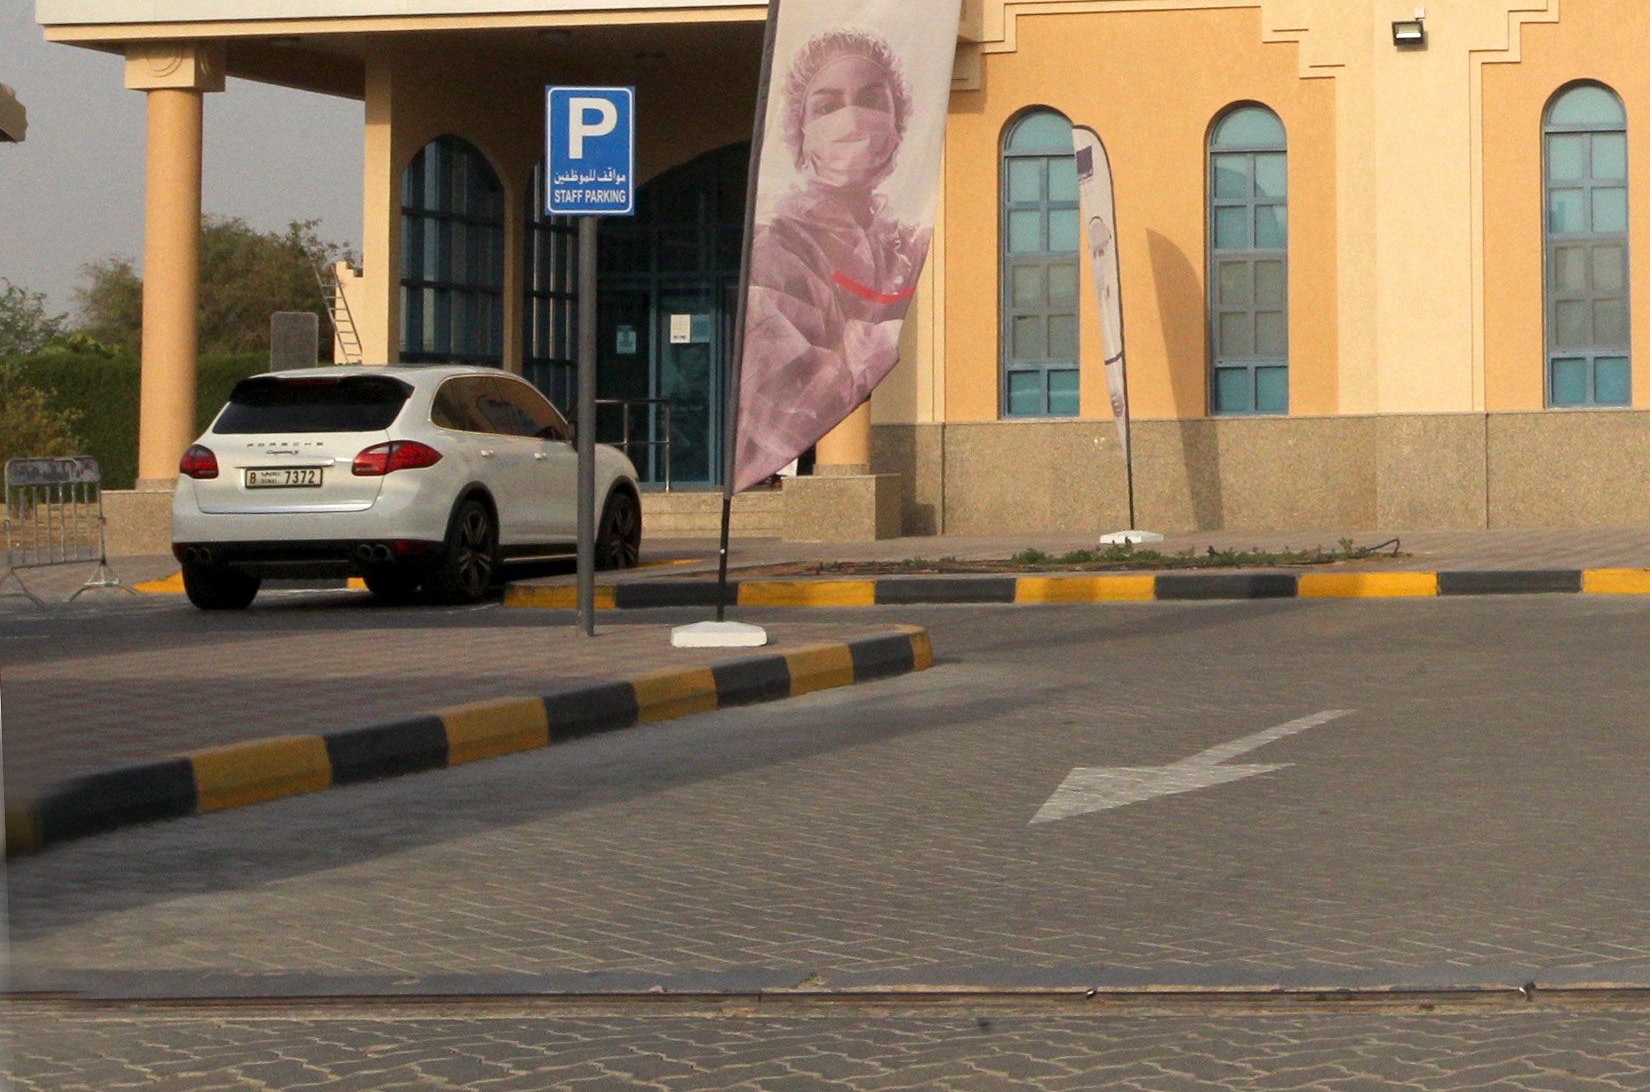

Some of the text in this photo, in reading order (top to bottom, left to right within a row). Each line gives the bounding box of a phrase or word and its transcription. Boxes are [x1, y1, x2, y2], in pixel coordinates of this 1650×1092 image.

[568, 97, 618, 159] P
[554, 167, 626, 185] مواقف للموظفين
[554, 190, 626, 203] STAFF PARKING
[285, 470, 315, 484] 7372
